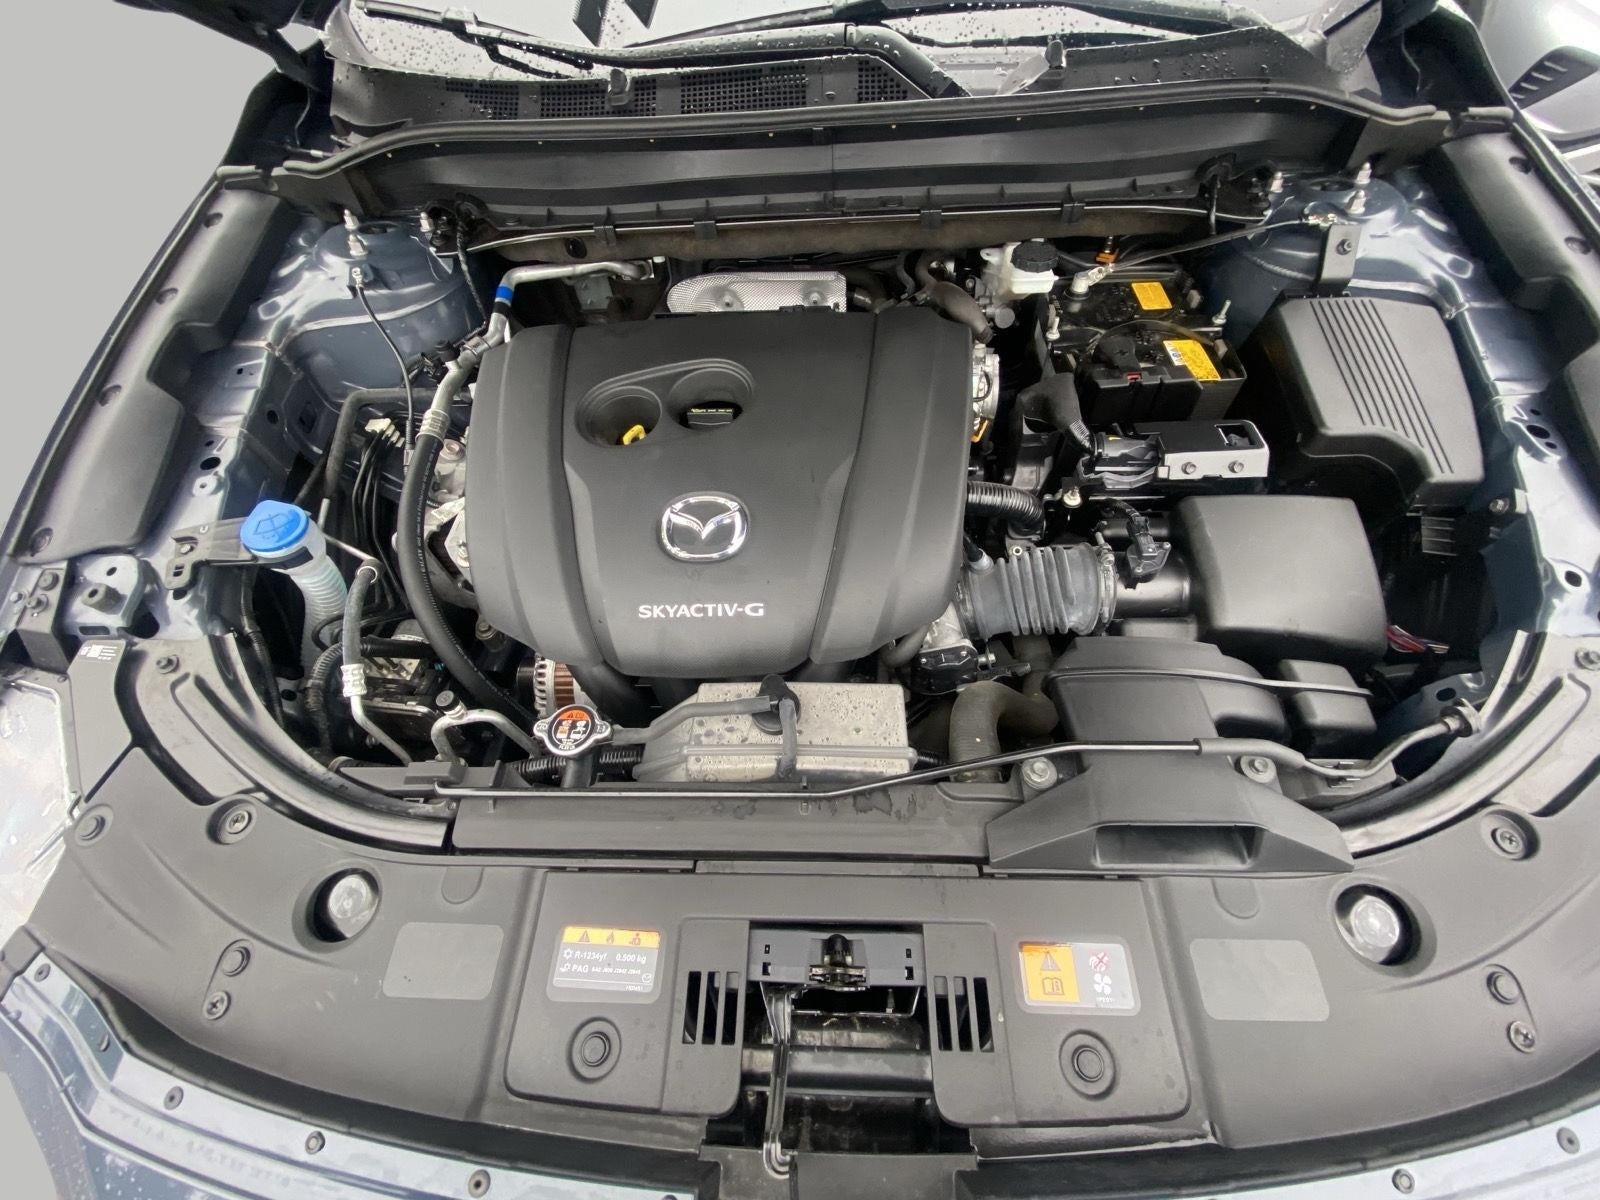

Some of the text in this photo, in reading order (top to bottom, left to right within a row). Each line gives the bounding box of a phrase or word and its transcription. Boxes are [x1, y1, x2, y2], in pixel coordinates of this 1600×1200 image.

[638, 602, 764, 619] SKYACTIV-G
[574, 950, 607, 962] R-1234yf
[571, 963, 589, 973] PAG
